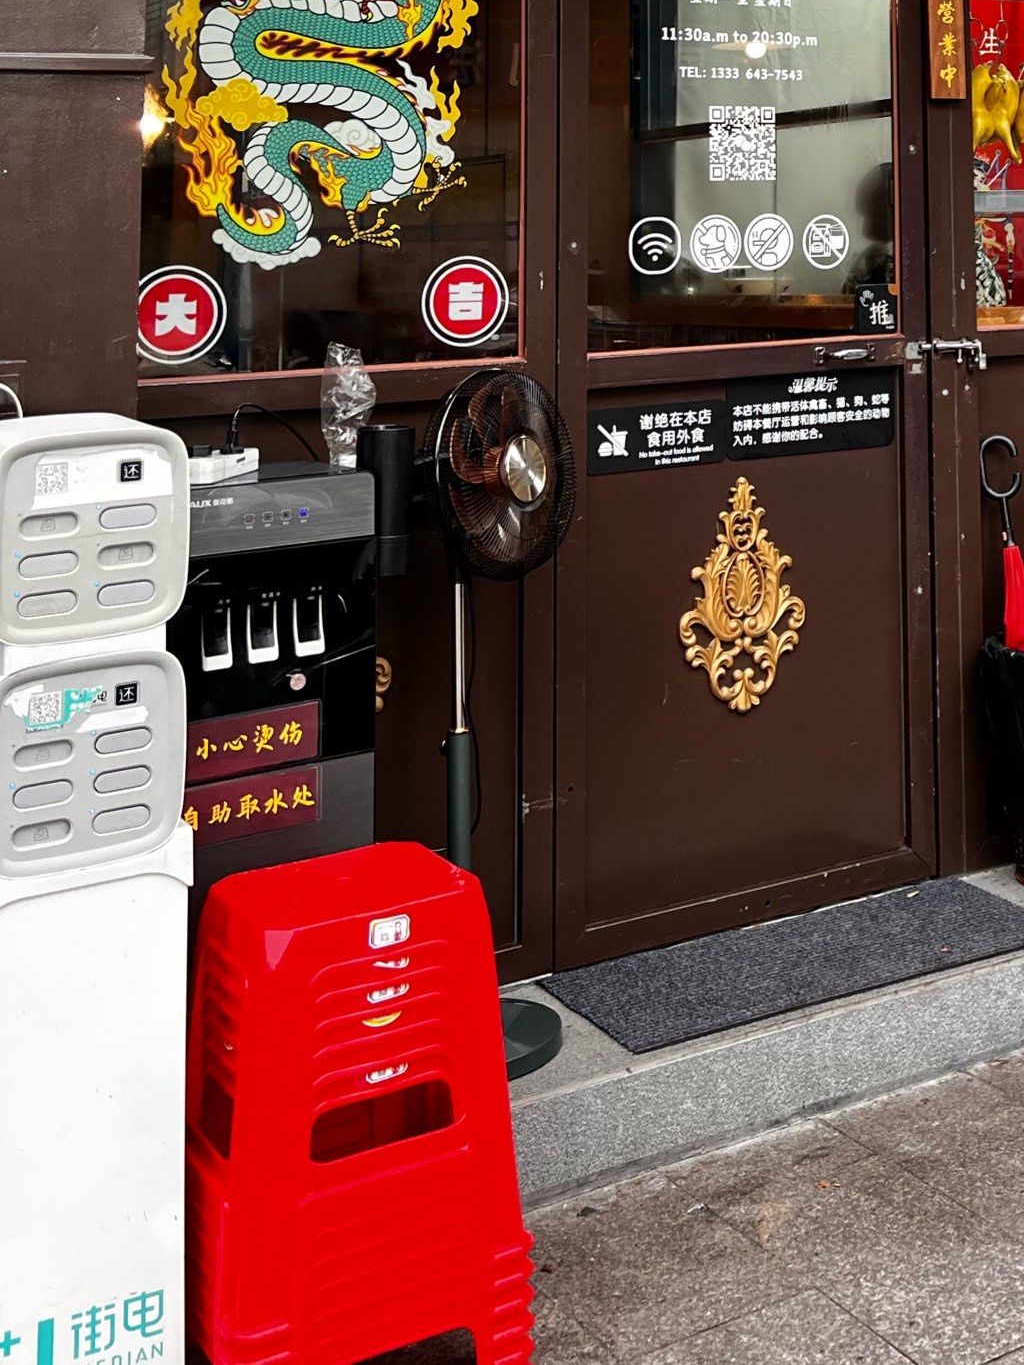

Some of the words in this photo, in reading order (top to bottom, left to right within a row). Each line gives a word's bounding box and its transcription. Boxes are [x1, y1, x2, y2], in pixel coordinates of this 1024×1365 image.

[660, 27, 729, 43] 11:30a.m
[732, 30, 749, 44] to
[751, 31, 819, 50] 20:30p.m
[937, 0, 958, 89] 營業中
[678, 66, 707, 80] TEL:
[710, 67, 740, 80] 1333
[745, 68, 804, 81] 643-7543
[447, 280, 485, 320] 吉
[154, 294, 197, 337] 大
[869, 299, 891, 325] 推
[639, 408, 712, 431] 谢绝在本店
[646, 427, 705, 448] 食用外食
[638, 451, 648, 459] No
[648, 449, 673, 458] take-out
[674, 446, 687, 455] food
[692, 443, 714, 453] allowed
[672, 454, 700, 464] restaurant
[122, 463, 140, 480] 还
[190, 499, 211, 509] AUX
[118, 686, 136, 703] 还
[196, 721, 303, 760] 小心烫伤
[184, 784, 316, 832] 自助取水处
[71, 1288, 165, 1360] 街电
